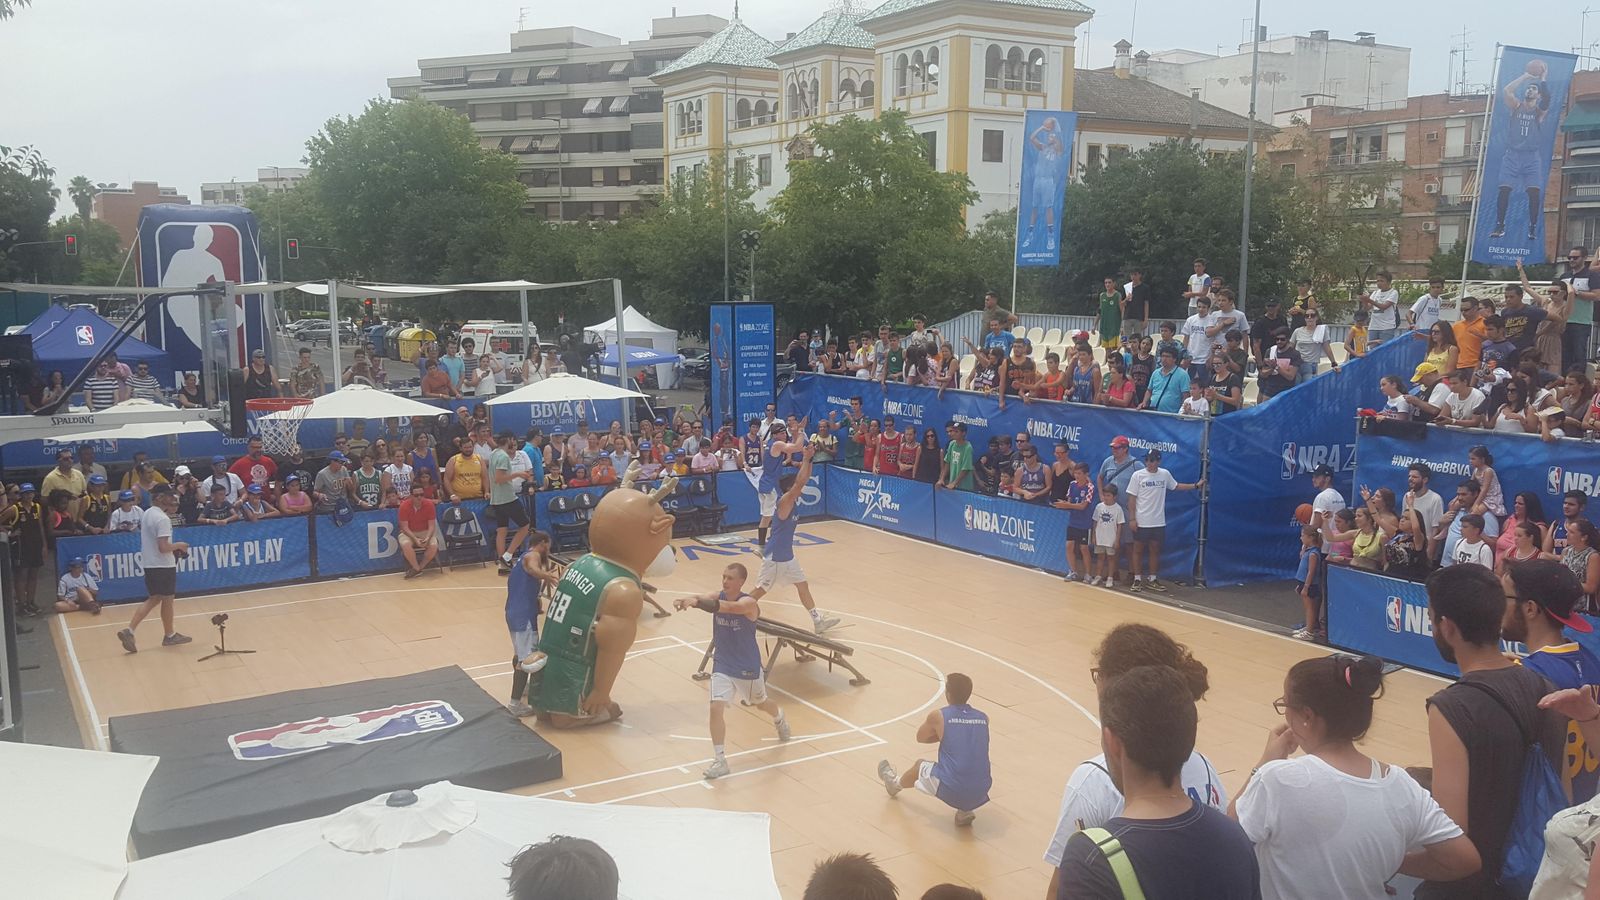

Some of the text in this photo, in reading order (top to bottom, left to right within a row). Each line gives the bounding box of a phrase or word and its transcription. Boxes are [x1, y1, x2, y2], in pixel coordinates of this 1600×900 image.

[531, 402, 573, 418] BBVA
[51, 415, 95, 426] SPALDING
[1033, 420, 1082, 442] NBA ZONE
[1127, 437, 1177, 453] NBAZoneBBVA
[1297, 444, 1340, 475] NBA
[858, 478, 876, 488] MEGA
[973, 509, 1036, 542] NBA ZONE
[105, 553, 145, 579] THIS
[214, 542, 241, 568] WE
[243, 537, 283, 566] PLAY
